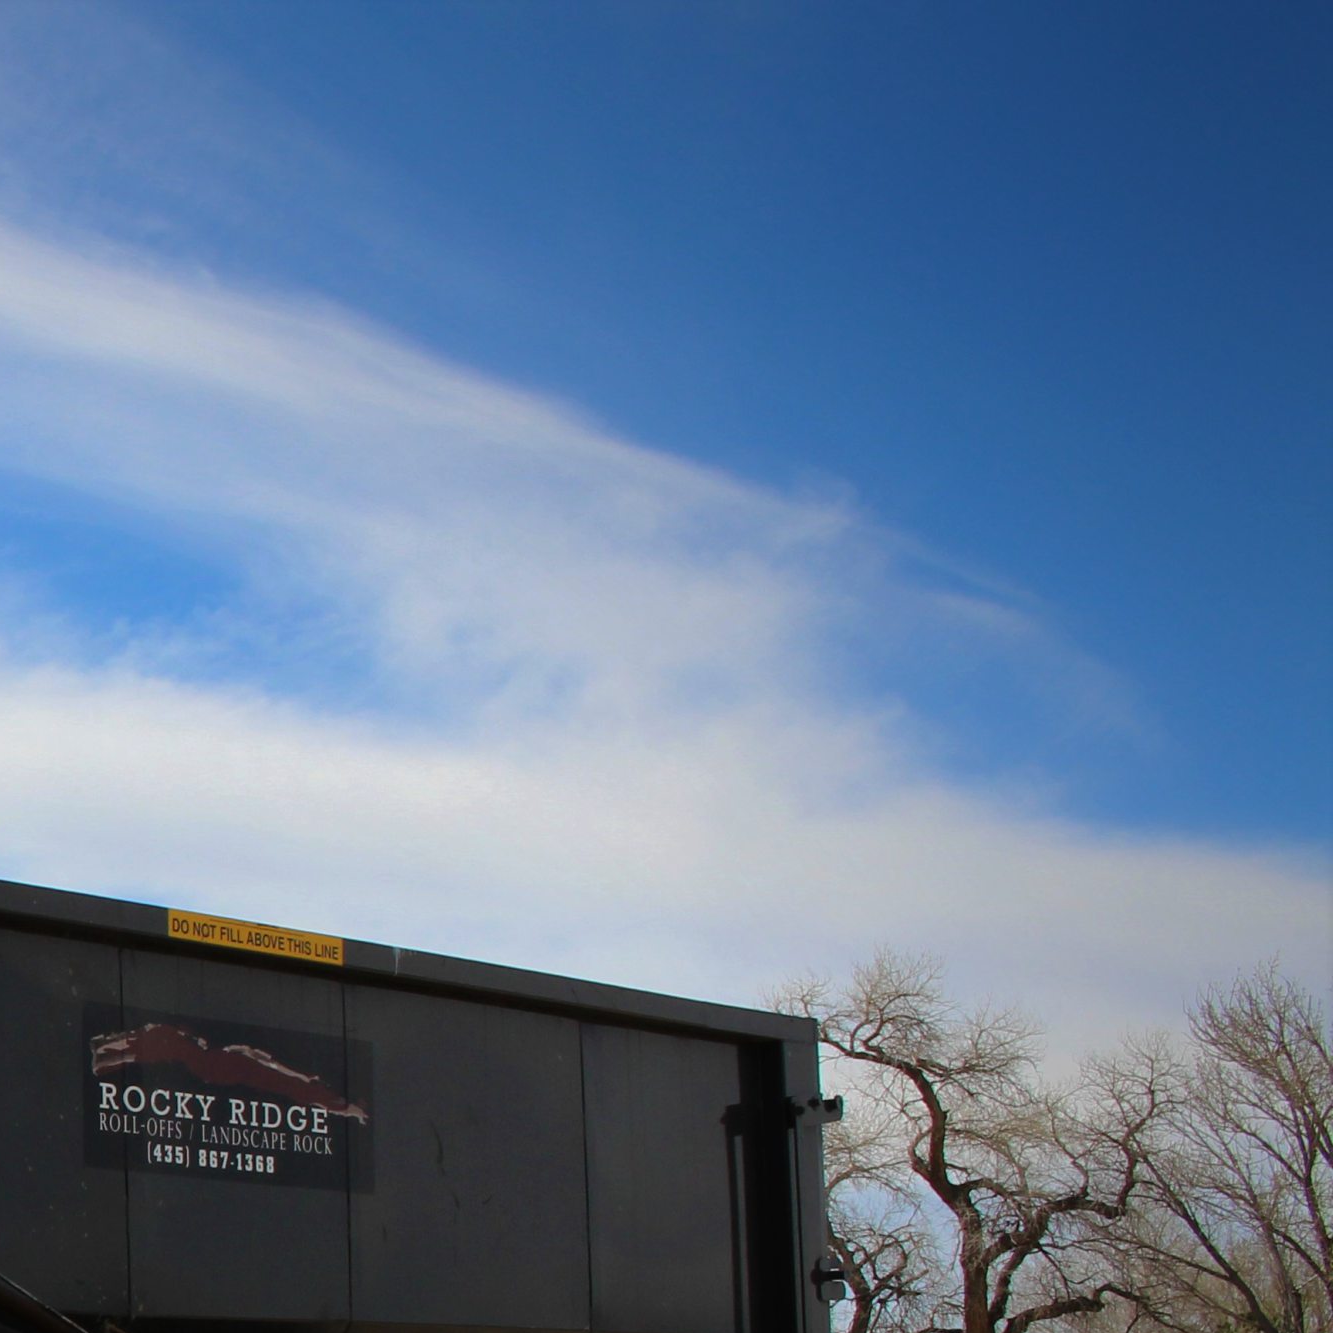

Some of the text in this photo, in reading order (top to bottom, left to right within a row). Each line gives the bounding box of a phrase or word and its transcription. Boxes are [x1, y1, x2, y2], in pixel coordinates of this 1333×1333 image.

[172, 918, 339, 960] DO NOT FILL ABOVE THIS LINE
[99, 1082, 329, 1134] ROCKY RIDGE
[99, 1112, 183, 1141] ROLL-OFFS
[201, 1124, 287, 1151] LANDSCAPE
[293, 1133, 333, 1155] ROCK
[147, 1141, 275, 1174] (435) 867-1368
